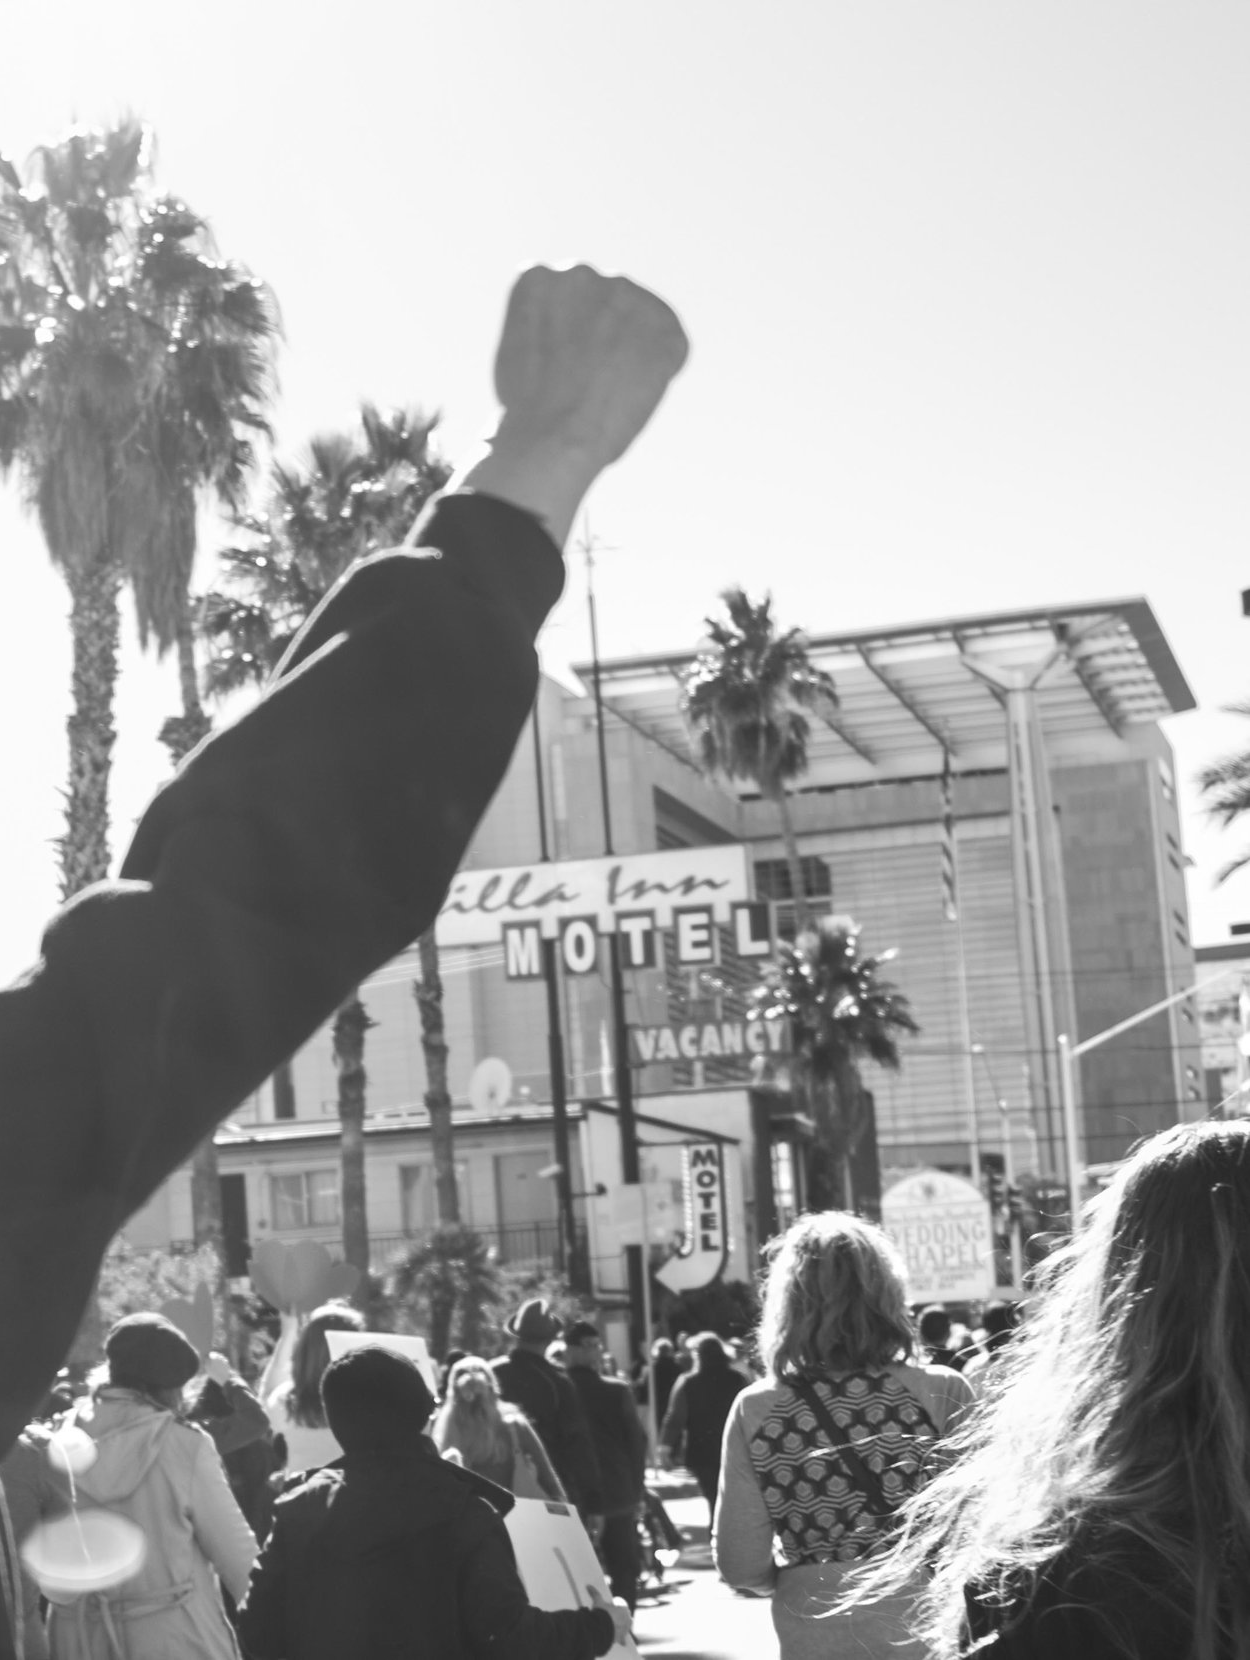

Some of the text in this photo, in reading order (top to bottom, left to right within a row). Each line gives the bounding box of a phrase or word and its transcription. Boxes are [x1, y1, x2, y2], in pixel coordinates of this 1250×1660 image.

[439, 864, 731, 914] illa Inn
[505, 907, 770, 978] MOTEL
[633, 1019, 785, 1061] VACANCY
[691, 1148, 719, 1253] MOTEL
[903, 1243, 986, 1273] HAPEL
